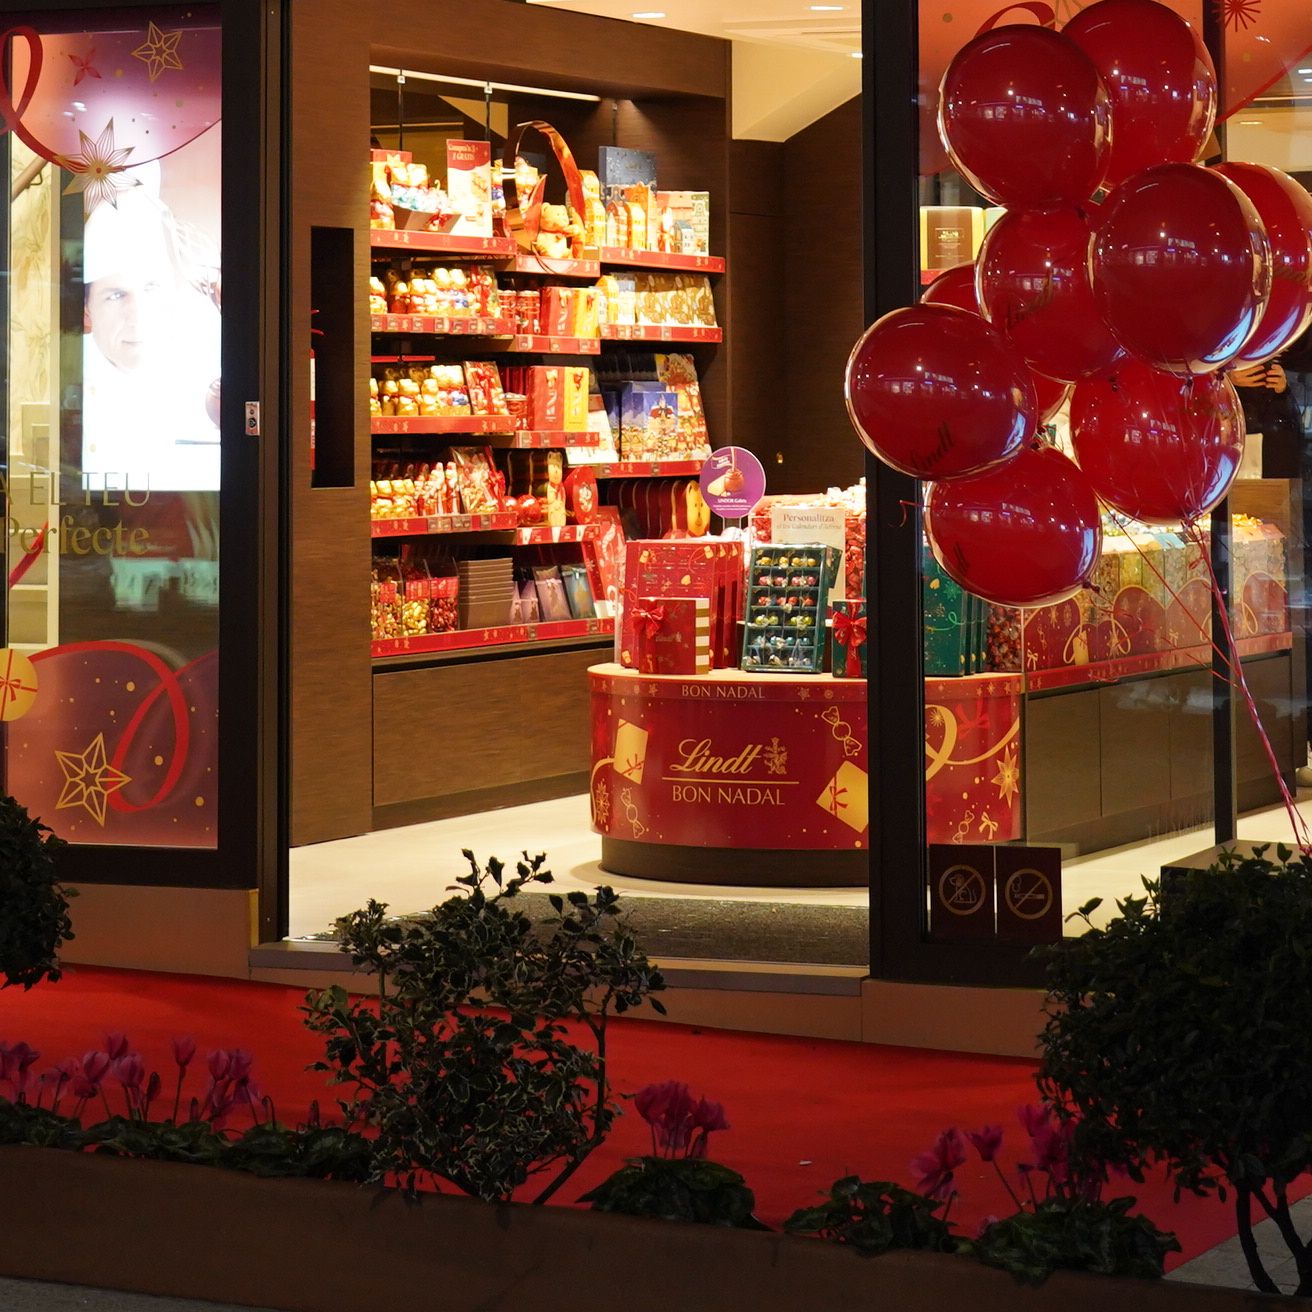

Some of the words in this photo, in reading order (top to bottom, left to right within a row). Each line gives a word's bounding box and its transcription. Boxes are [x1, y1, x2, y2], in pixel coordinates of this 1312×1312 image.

[29, 471, 67, 507] EL
[80, 471, 151, 507] TEU
[783, 513, 835, 523] Personalitza
[681, 684, 711, 698] BON
[716, 685, 765, 699] NADAL
[669, 738, 763, 774] Lindt
[672, 784, 711, 803] BON
[718, 787, 785, 806] NADAL
